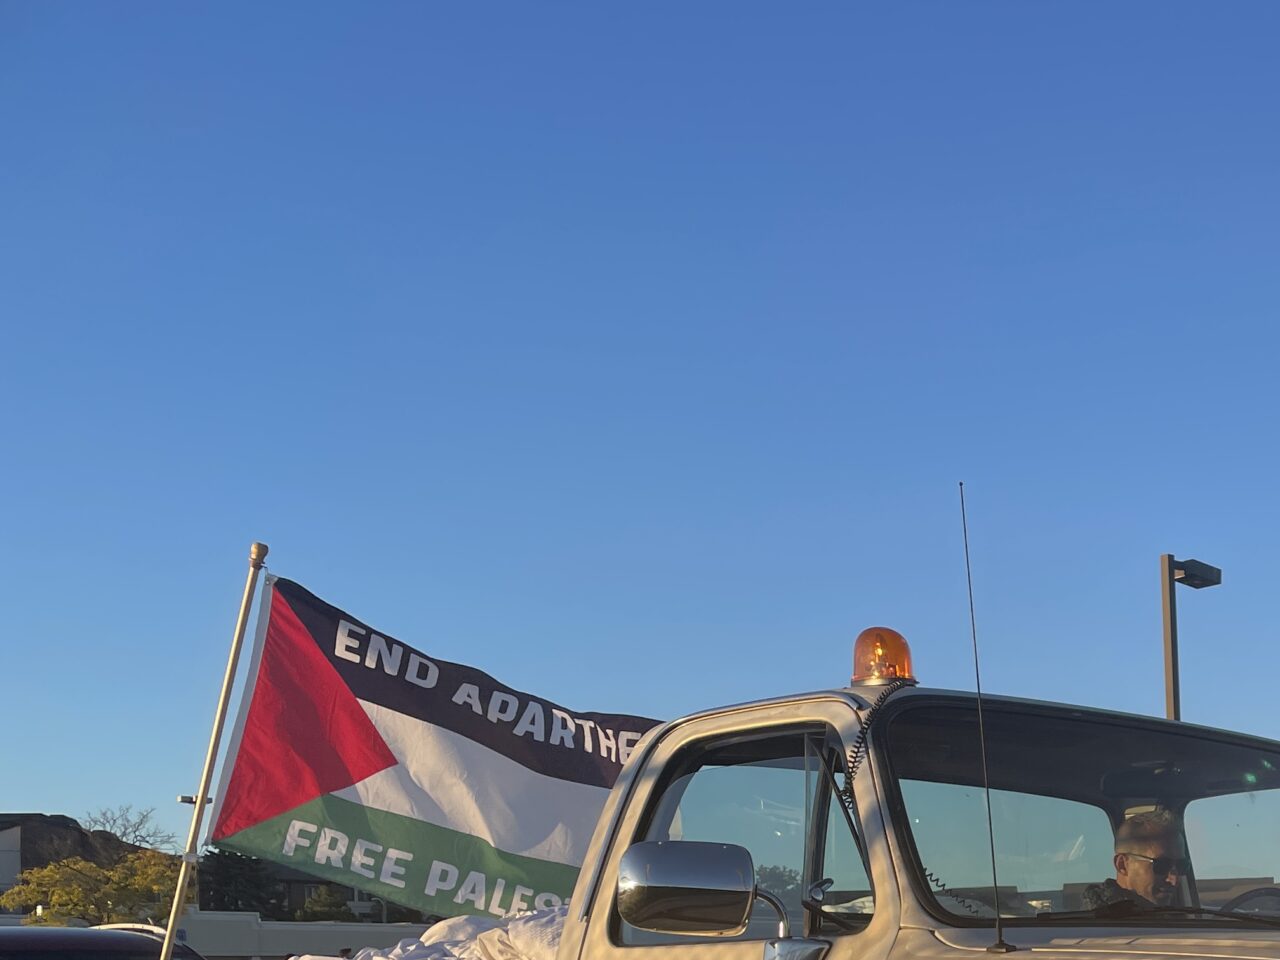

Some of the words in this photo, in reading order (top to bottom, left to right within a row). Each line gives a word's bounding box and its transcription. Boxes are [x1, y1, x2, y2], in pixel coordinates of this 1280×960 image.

[334, 619, 440, 689] END
[451, 682, 642, 766] APARTHE
[282, 819, 414, 888] FREE
[424, 860, 572, 918] PALES
